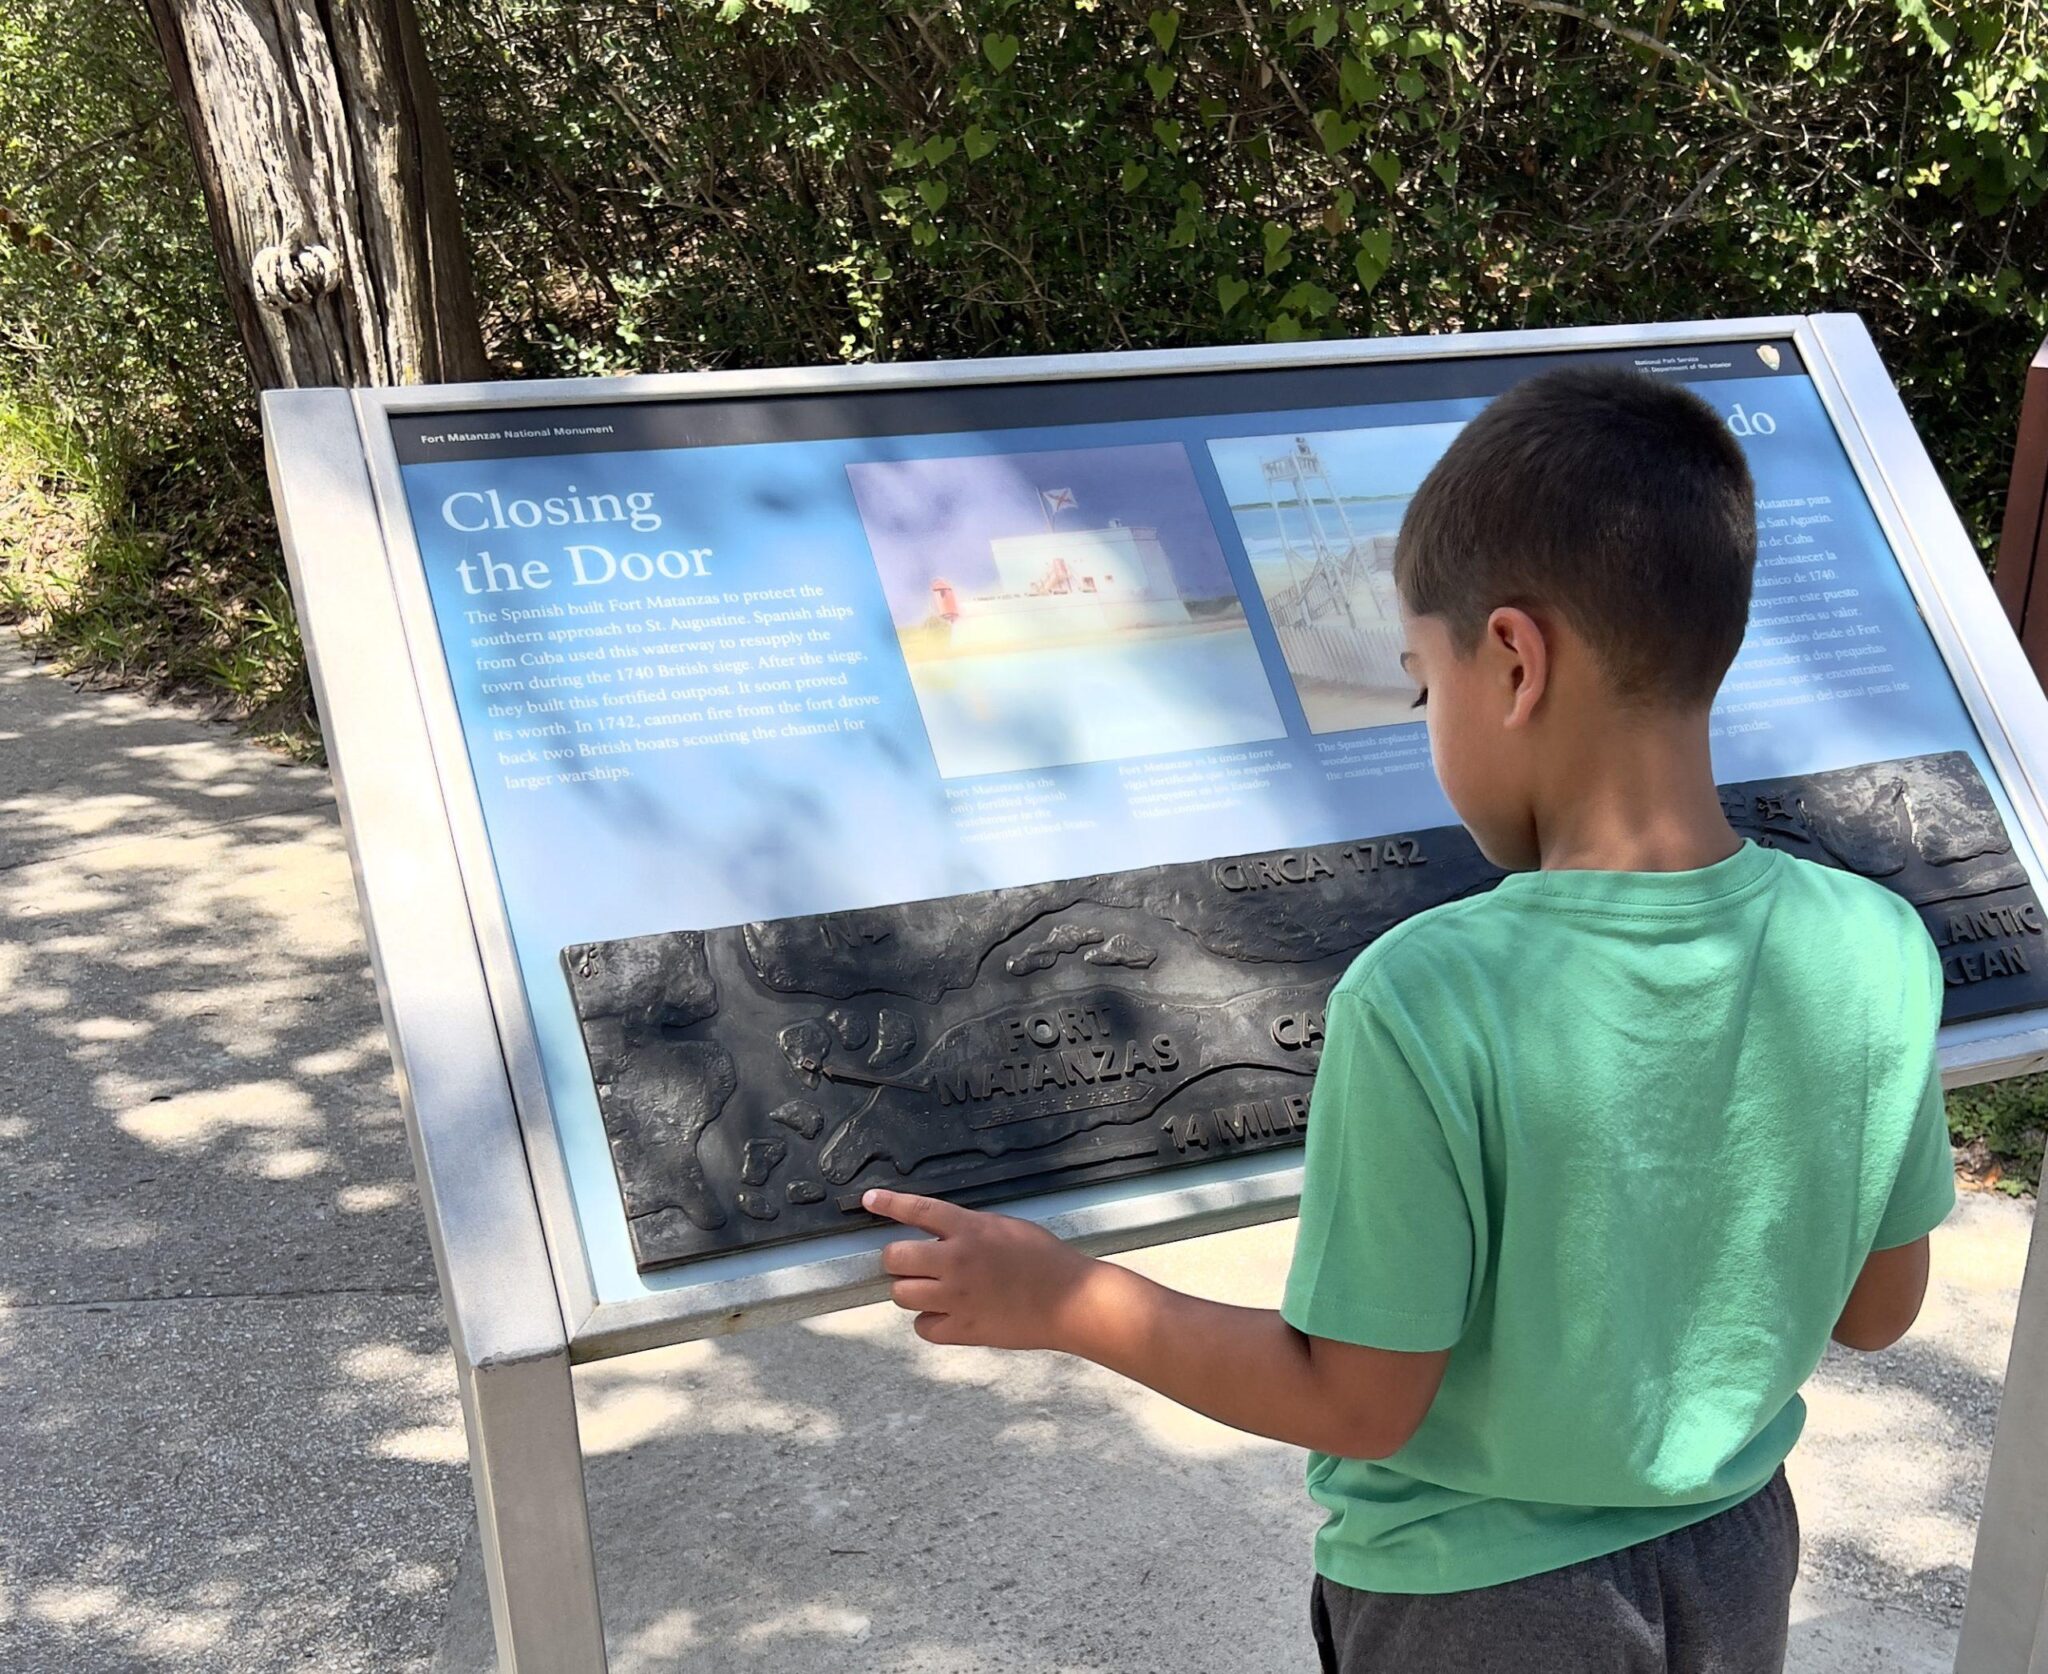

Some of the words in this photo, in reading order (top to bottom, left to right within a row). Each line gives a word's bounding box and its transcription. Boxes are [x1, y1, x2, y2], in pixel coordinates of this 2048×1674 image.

[421, 434, 444, 444] Fort
[447, 431, 501, 443] Matanzas
[504, 428, 551, 439] National
[554, 424, 614, 436] Monument
[441, 485, 661, 532] Closing
[1767, 517, 1788, 528] San
[1806, 496, 1832, 508] para
[1769, 536, 1783, 546] de
[1784, 534, 1815, 544] Cuba
[1825, 550, 1838, 560] la
[455, 550, 552, 595] the
[564, 542, 713, 586] Door
[1794, 572, 1807, 583] de
[464, 609, 498, 625] The
[502, 603, 564, 624] Spanish
[568, 600, 604, 615] built
[609, 598, 642, 612] Fort
[647, 594, 720, 609] Matanzas
[723, 592, 739, 604] to
[743, 586, 796, 607] protect
[799, 583, 824, 597] the
[1822, 588, 1860, 602] puesto
[470, 632, 543, 648] southern
[548, 622, 621, 643] approach
[626, 622, 642, 634] to
[646, 620, 666, 633] St.
[671, 613, 750, 632] Augustine.
[753, 607, 812, 626] Spanish
[816, 604, 854, 621] ships
[1812, 628, 1844, 640] desde
[1846, 626, 1856, 637] el
[1857, 624, 1881, 635] Fort
[476, 656, 516, 671] from
[520, 651, 564, 666] Cuba
[568, 646, 605, 662] used
[609, 643, 639, 658] this
[642, 638, 715, 655] waterway
[719, 638, 736, 649] to
[740, 630, 804, 651] resupply
[807, 628, 831, 641] the
[1812, 650, 1833, 661] dos
[481, 679, 524, 695] town
[528, 672, 584, 690] during
[586, 669, 611, 684] the
[616, 666, 653, 682] 1740
[658, 661, 708, 678] British
[713, 659, 754, 675] siege.
[757, 654, 795, 670] After
[799, 651, 824, 666] the
[827, 649, 868, 665] siege,
[488, 703, 523, 720] they
[526, 699, 565, 715] built
[569, 695, 598, 710] this
[603, 687, 667, 706] fortified
[671, 683, 734, 700] outpost.
[738, 681, 750, 695] It
[754, 679, 791, 693] soon
[795, 671, 848, 692] proved
[1817, 690, 1834, 702] del
[493, 728, 513, 742] its
[516, 724, 571, 740] worth.
[575, 720, 593, 733] In
[598, 715, 641, 731] 1742,
[644, 712, 703, 726] cannon
[707, 706, 733, 721] fire
[736, 703, 774, 717] from
[778, 700, 803, 714] the
[806, 697, 834, 711] fort
[838, 693, 880, 709] drove
[498, 749, 539, 766] back
[543, 747, 574, 761] two
[578, 740, 632, 757] British
[635, 735, 679, 751] boats
[683, 730, 750, 746] scouting
[752, 726, 777, 740] the
[780, 719, 840, 737] channel
[843, 718, 866, 731] for
[503, 773, 553, 791] larger
[557, 764, 635, 784] warships.
[1215, 853, 1335, 894] CIRCA
[1342, 838, 1429, 874] 1742
[1943, 945, 2032, 986] CEAN
[1003, 1003, 1112, 1052] FORT
[929, 1033, 1180, 1105] MATANZAS
[1161, 1114, 1210, 1154] 14
[1212, 1092, 1311, 1148] MILE
